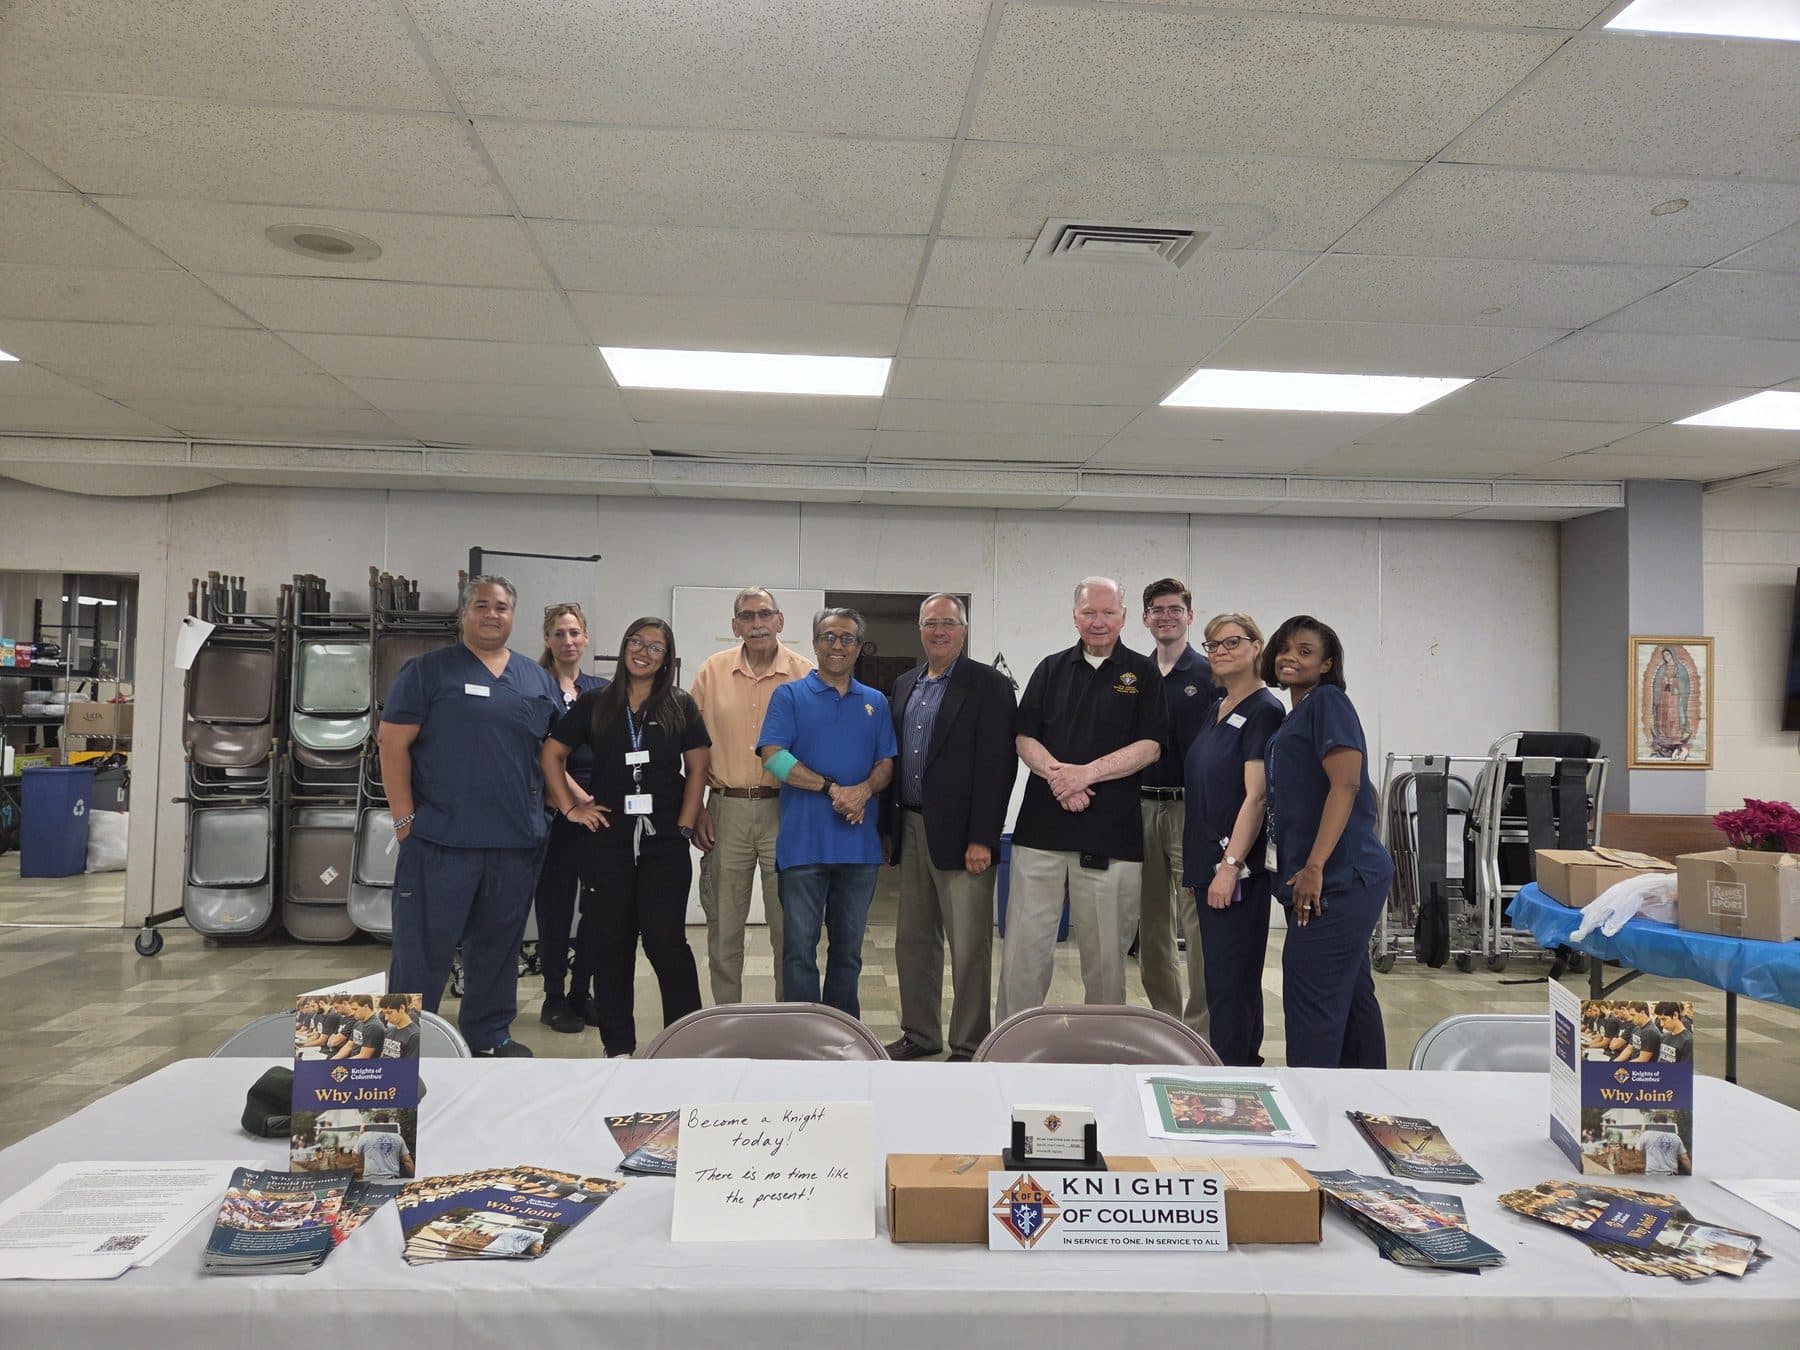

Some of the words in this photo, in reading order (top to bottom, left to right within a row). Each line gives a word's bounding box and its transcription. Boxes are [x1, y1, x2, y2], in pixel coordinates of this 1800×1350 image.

[1711, 899, 1743, 909] SPORT
[351, 1067, 373, 1075] Knights
[315, 1088, 352, 1104] Why
[354, 1087, 396, 1101] Join?
[1600, 1088, 1633, 1103] Why
[1636, 1089, 1673, 1102] Join?
[638, 1113, 668, 1124] 24
[687, 1108, 749, 1128] Become
[782, 1107, 827, 1132] Knight
[1363, 1113, 1394, 1126] 24
[732, 1130, 793, 1156] today!
[695, 1168, 733, 1182] There
[742, 1166, 756, 1181] is
[764, 1172, 781, 1181] no
[788, 1167, 818, 1181] time
[826, 1166, 849, 1180] like
[1062, 1177, 1219, 1196] KNIGHTS
[726, 1188, 744, 1204] the
[753, 1186, 815, 1208] present!
[1011, 1192, 1019, 1202] K
[1034, 1192, 1042, 1201] C
[486, 1200, 519, 1213] Why
[519, 1207, 562, 1219] Join?
[1062, 1208, 1092, 1224] OF
[1097, 1208, 1219, 1224] COLUMBUS
